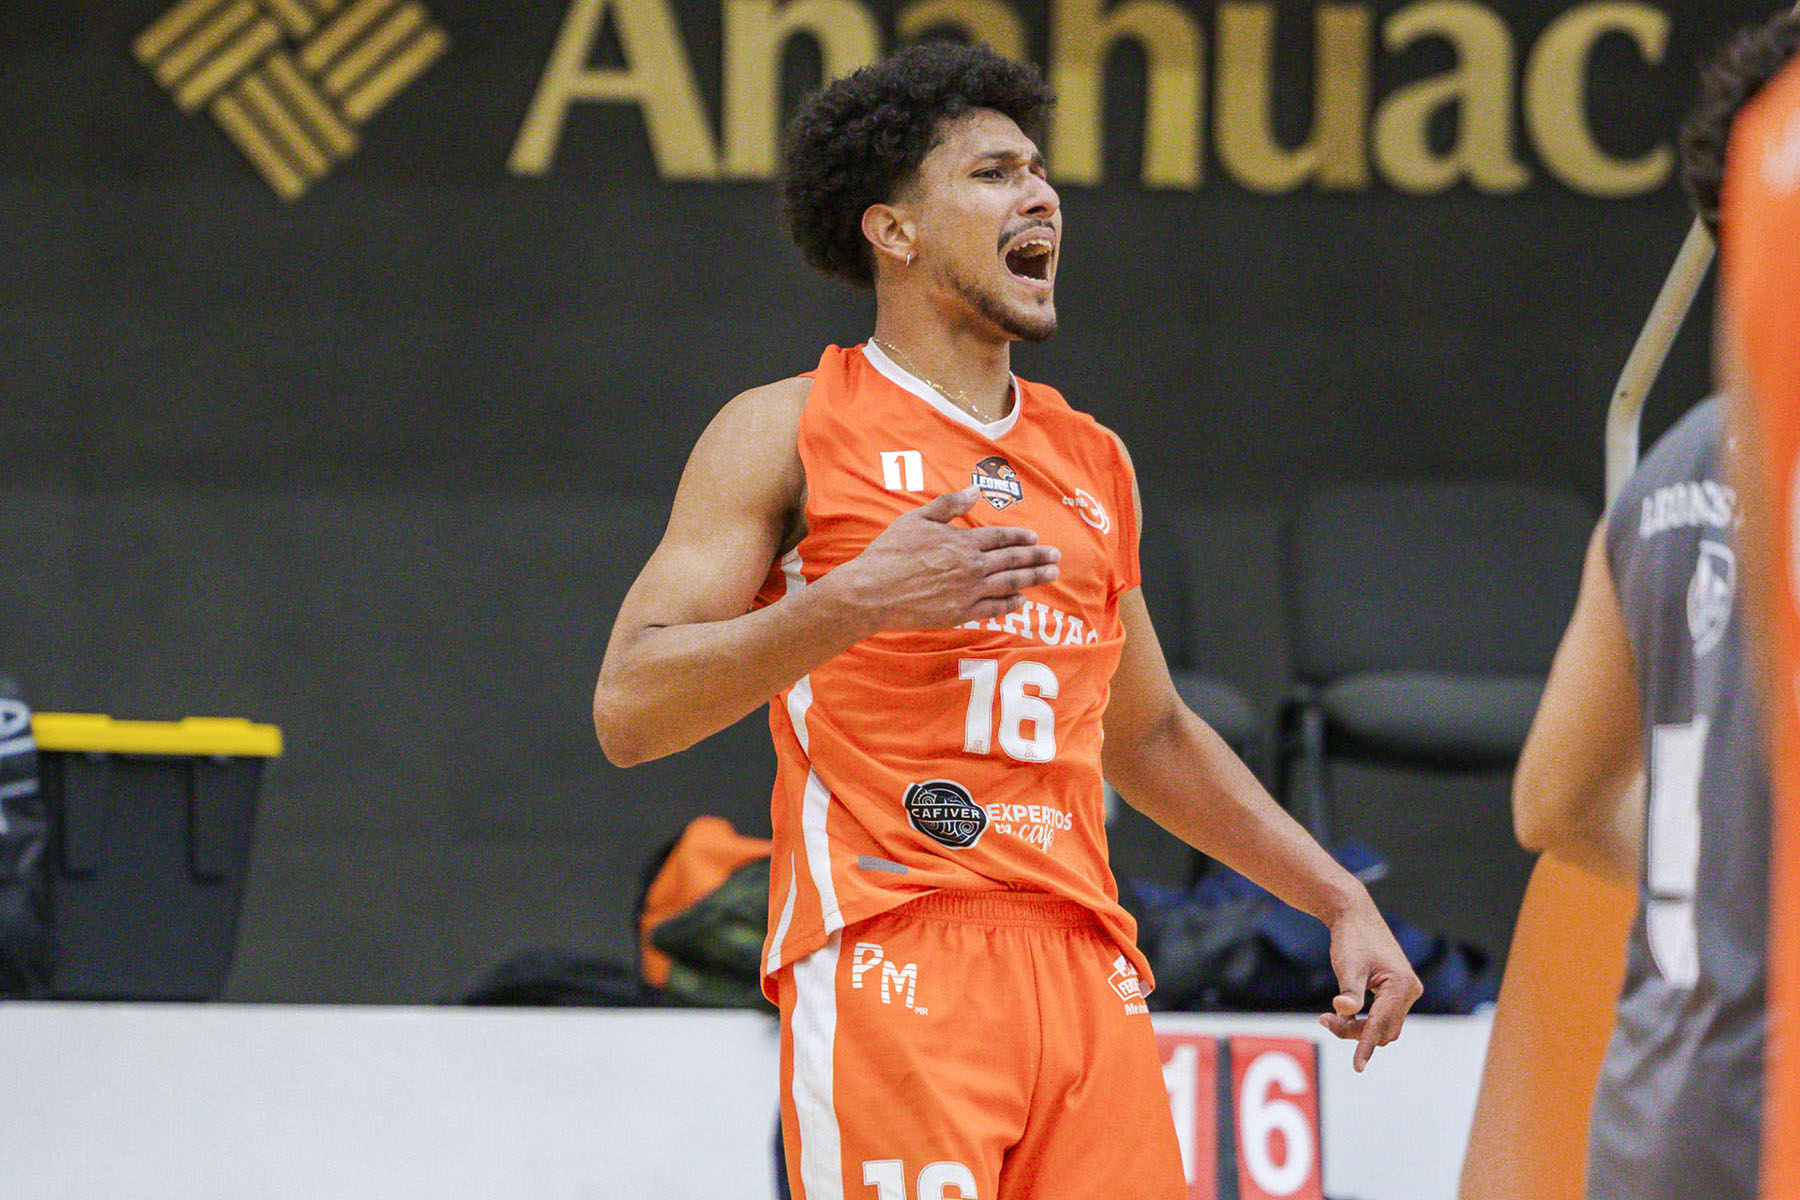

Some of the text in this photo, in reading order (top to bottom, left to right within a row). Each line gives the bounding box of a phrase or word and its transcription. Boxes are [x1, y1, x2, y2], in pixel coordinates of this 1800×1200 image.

[972, 474, 1021, 498] LEONES
[958, 658, 1059, 763] 16
[911, 808, 981, 819] CAFIVER
[985, 803, 1073, 831] EXPERTOS
